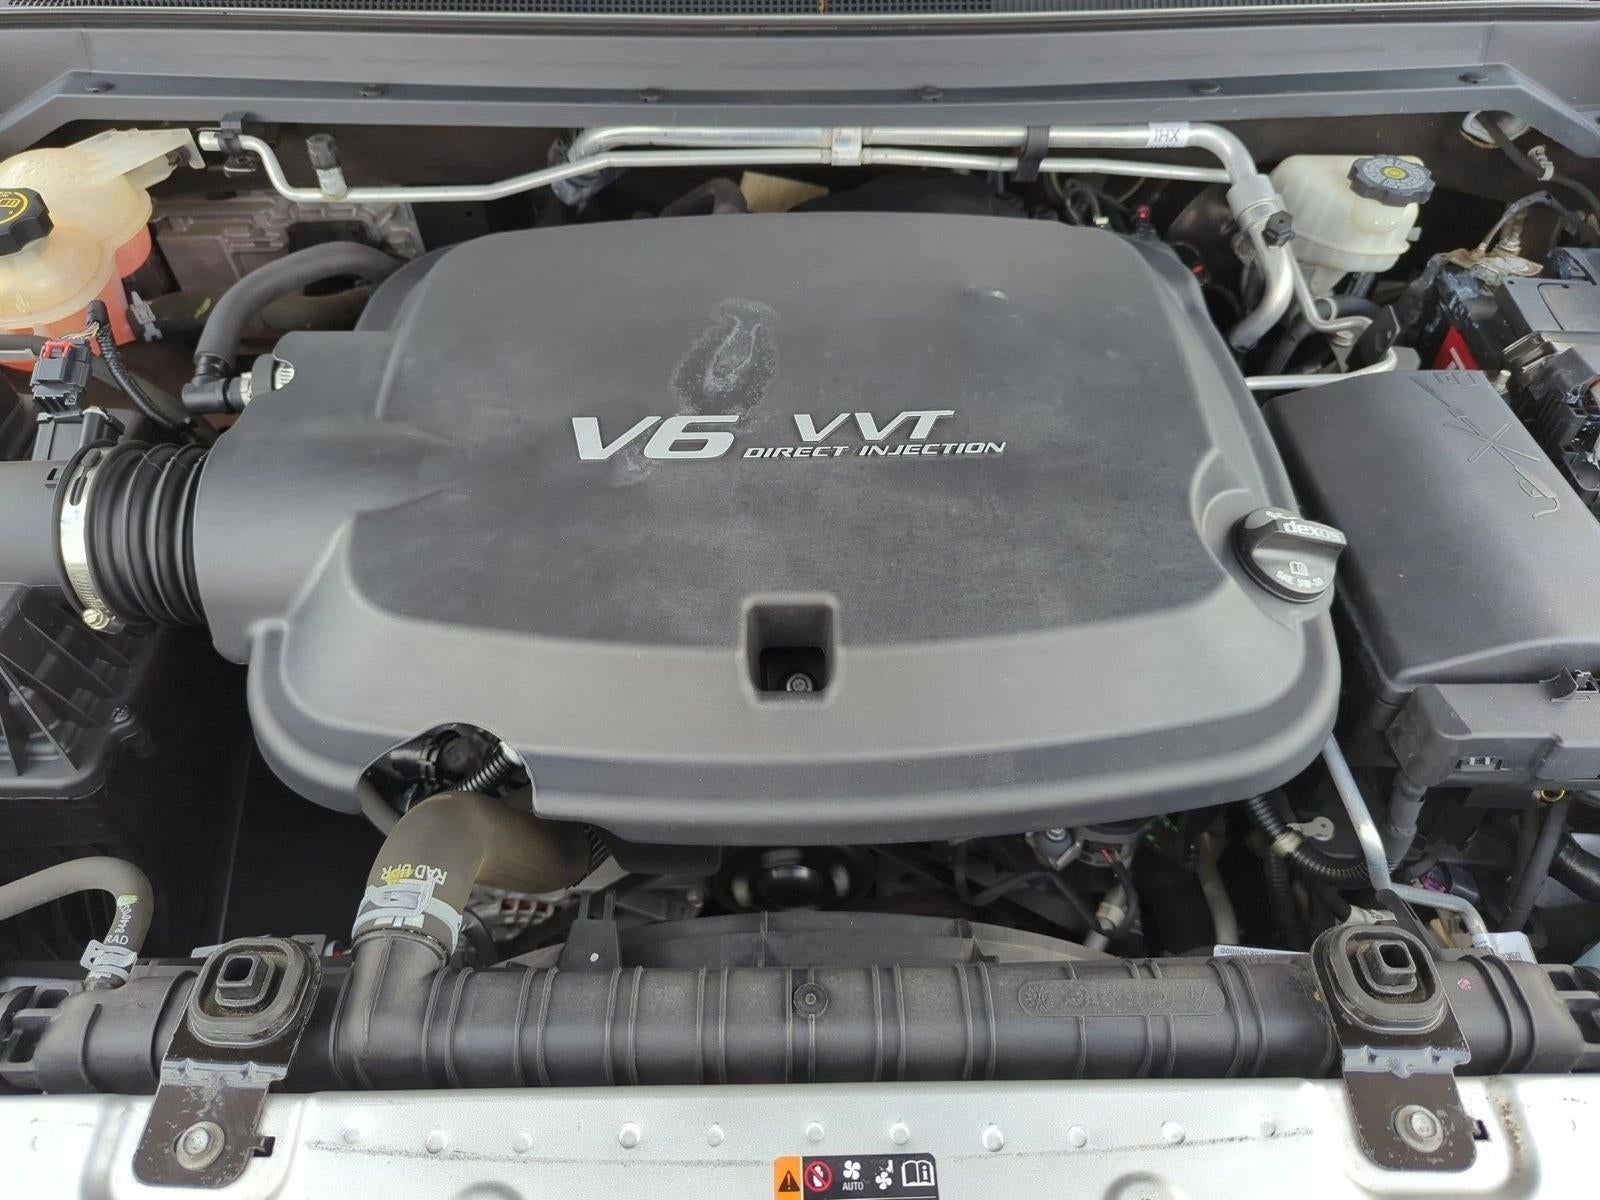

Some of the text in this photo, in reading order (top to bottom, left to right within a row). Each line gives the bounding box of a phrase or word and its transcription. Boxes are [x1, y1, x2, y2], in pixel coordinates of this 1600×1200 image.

[571, 409, 955, 461] V6 VVT
[742, 441, 1007, 459] DIRECT INJECTION
[1282, 520, 1343, 543] dexos
[415, 864, 448, 886] RAD
[103, 935, 130, 946] RAD
[842, 1181, 865, 1192] AUTO
